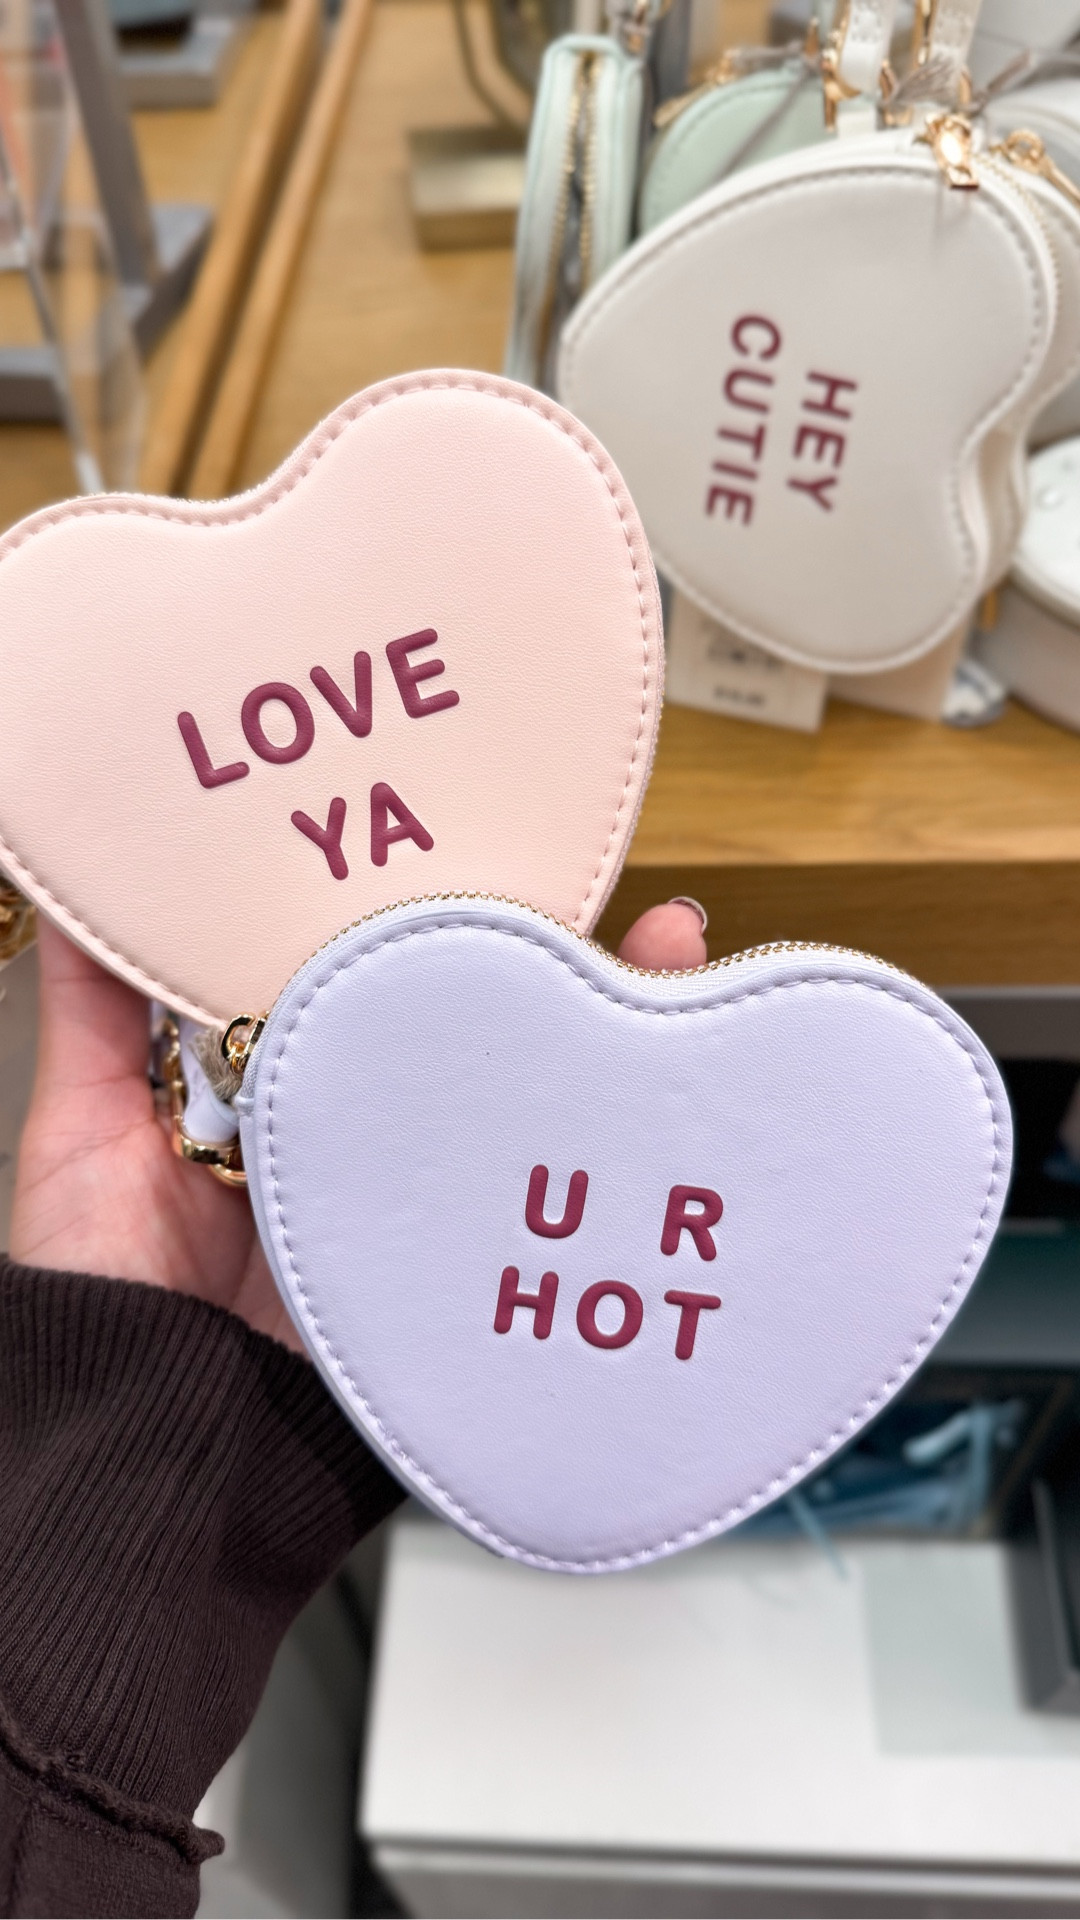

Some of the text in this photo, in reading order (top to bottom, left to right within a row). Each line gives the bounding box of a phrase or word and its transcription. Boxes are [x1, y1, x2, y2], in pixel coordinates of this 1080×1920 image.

[705, 313, 782, 528] CUTIE
[786, 369, 859, 514] HEY
[177, 628, 460, 790] LOVE
[290, 782, 435, 881] YA
[524, 1164, 724, 1262] U R
[493, 1266, 722, 1361] HOT
